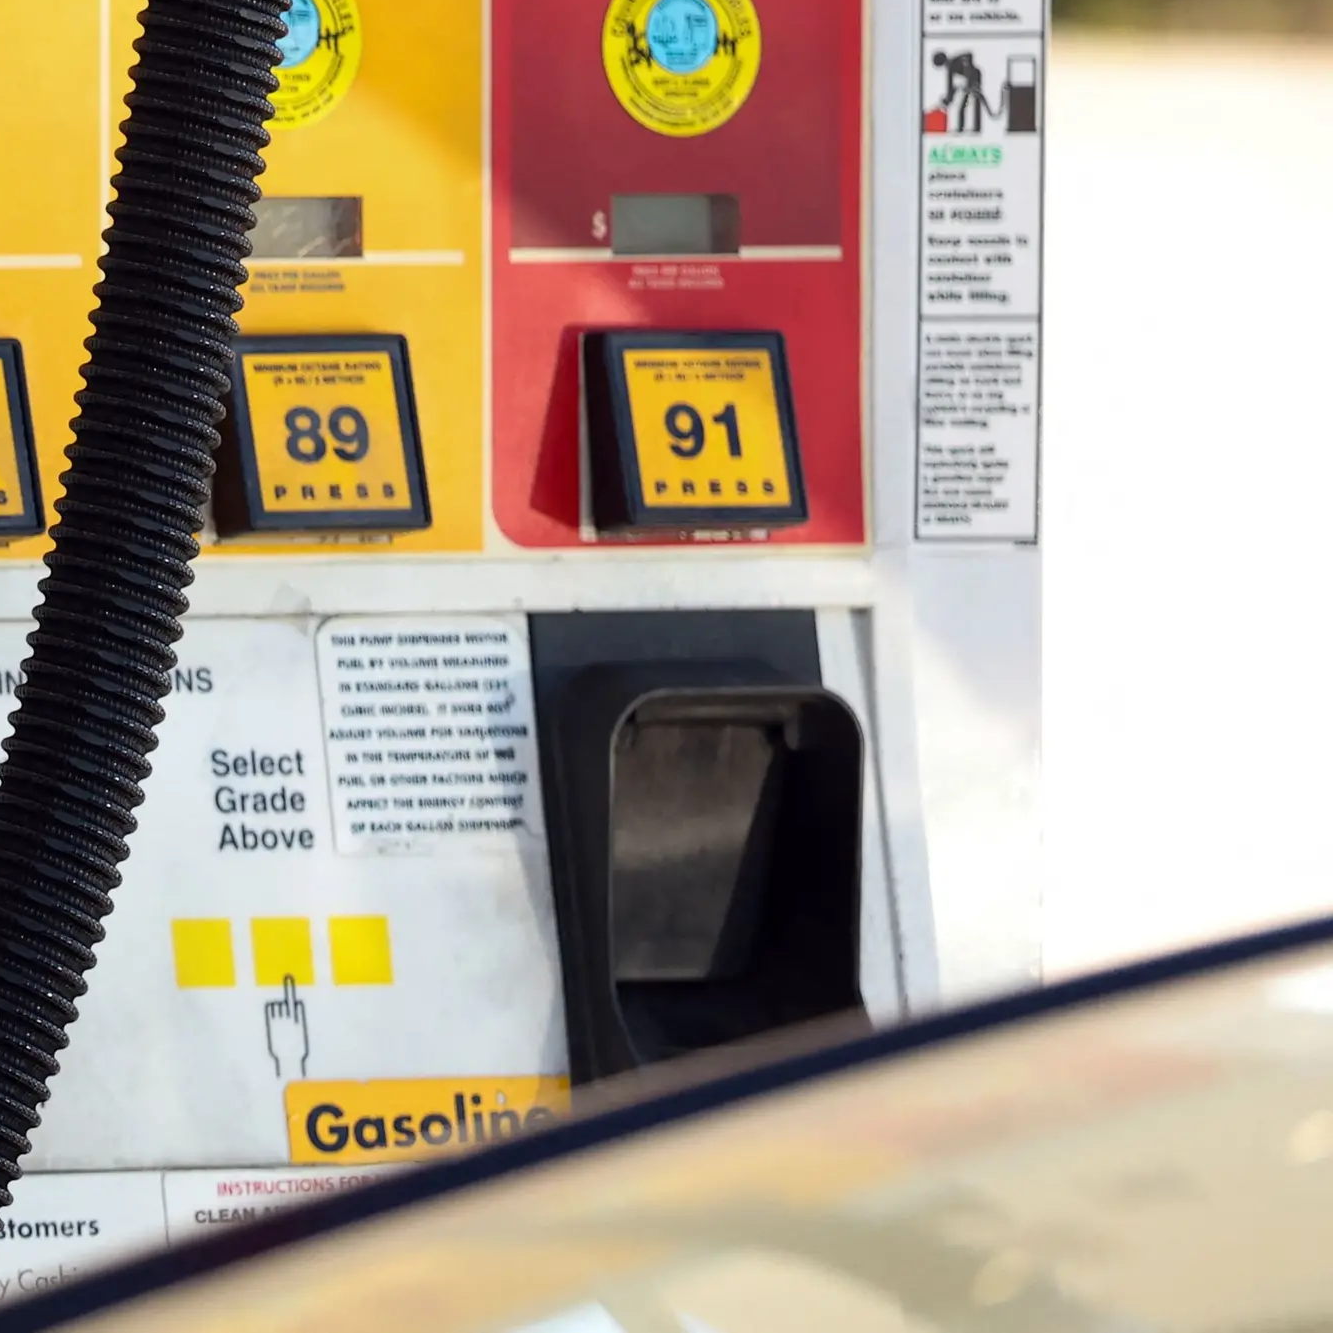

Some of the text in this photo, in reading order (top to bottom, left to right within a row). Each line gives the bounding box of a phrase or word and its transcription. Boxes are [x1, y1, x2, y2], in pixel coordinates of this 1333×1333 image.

[284, 405, 370, 464] 89
[664, 401, 743, 459] 91
[210, 747, 305, 777] Select
[214, 785, 306, 814] Grade
[219, 823, 315, 851] Above
[216, 1176, 335, 1196] INSTRUCTIONS
